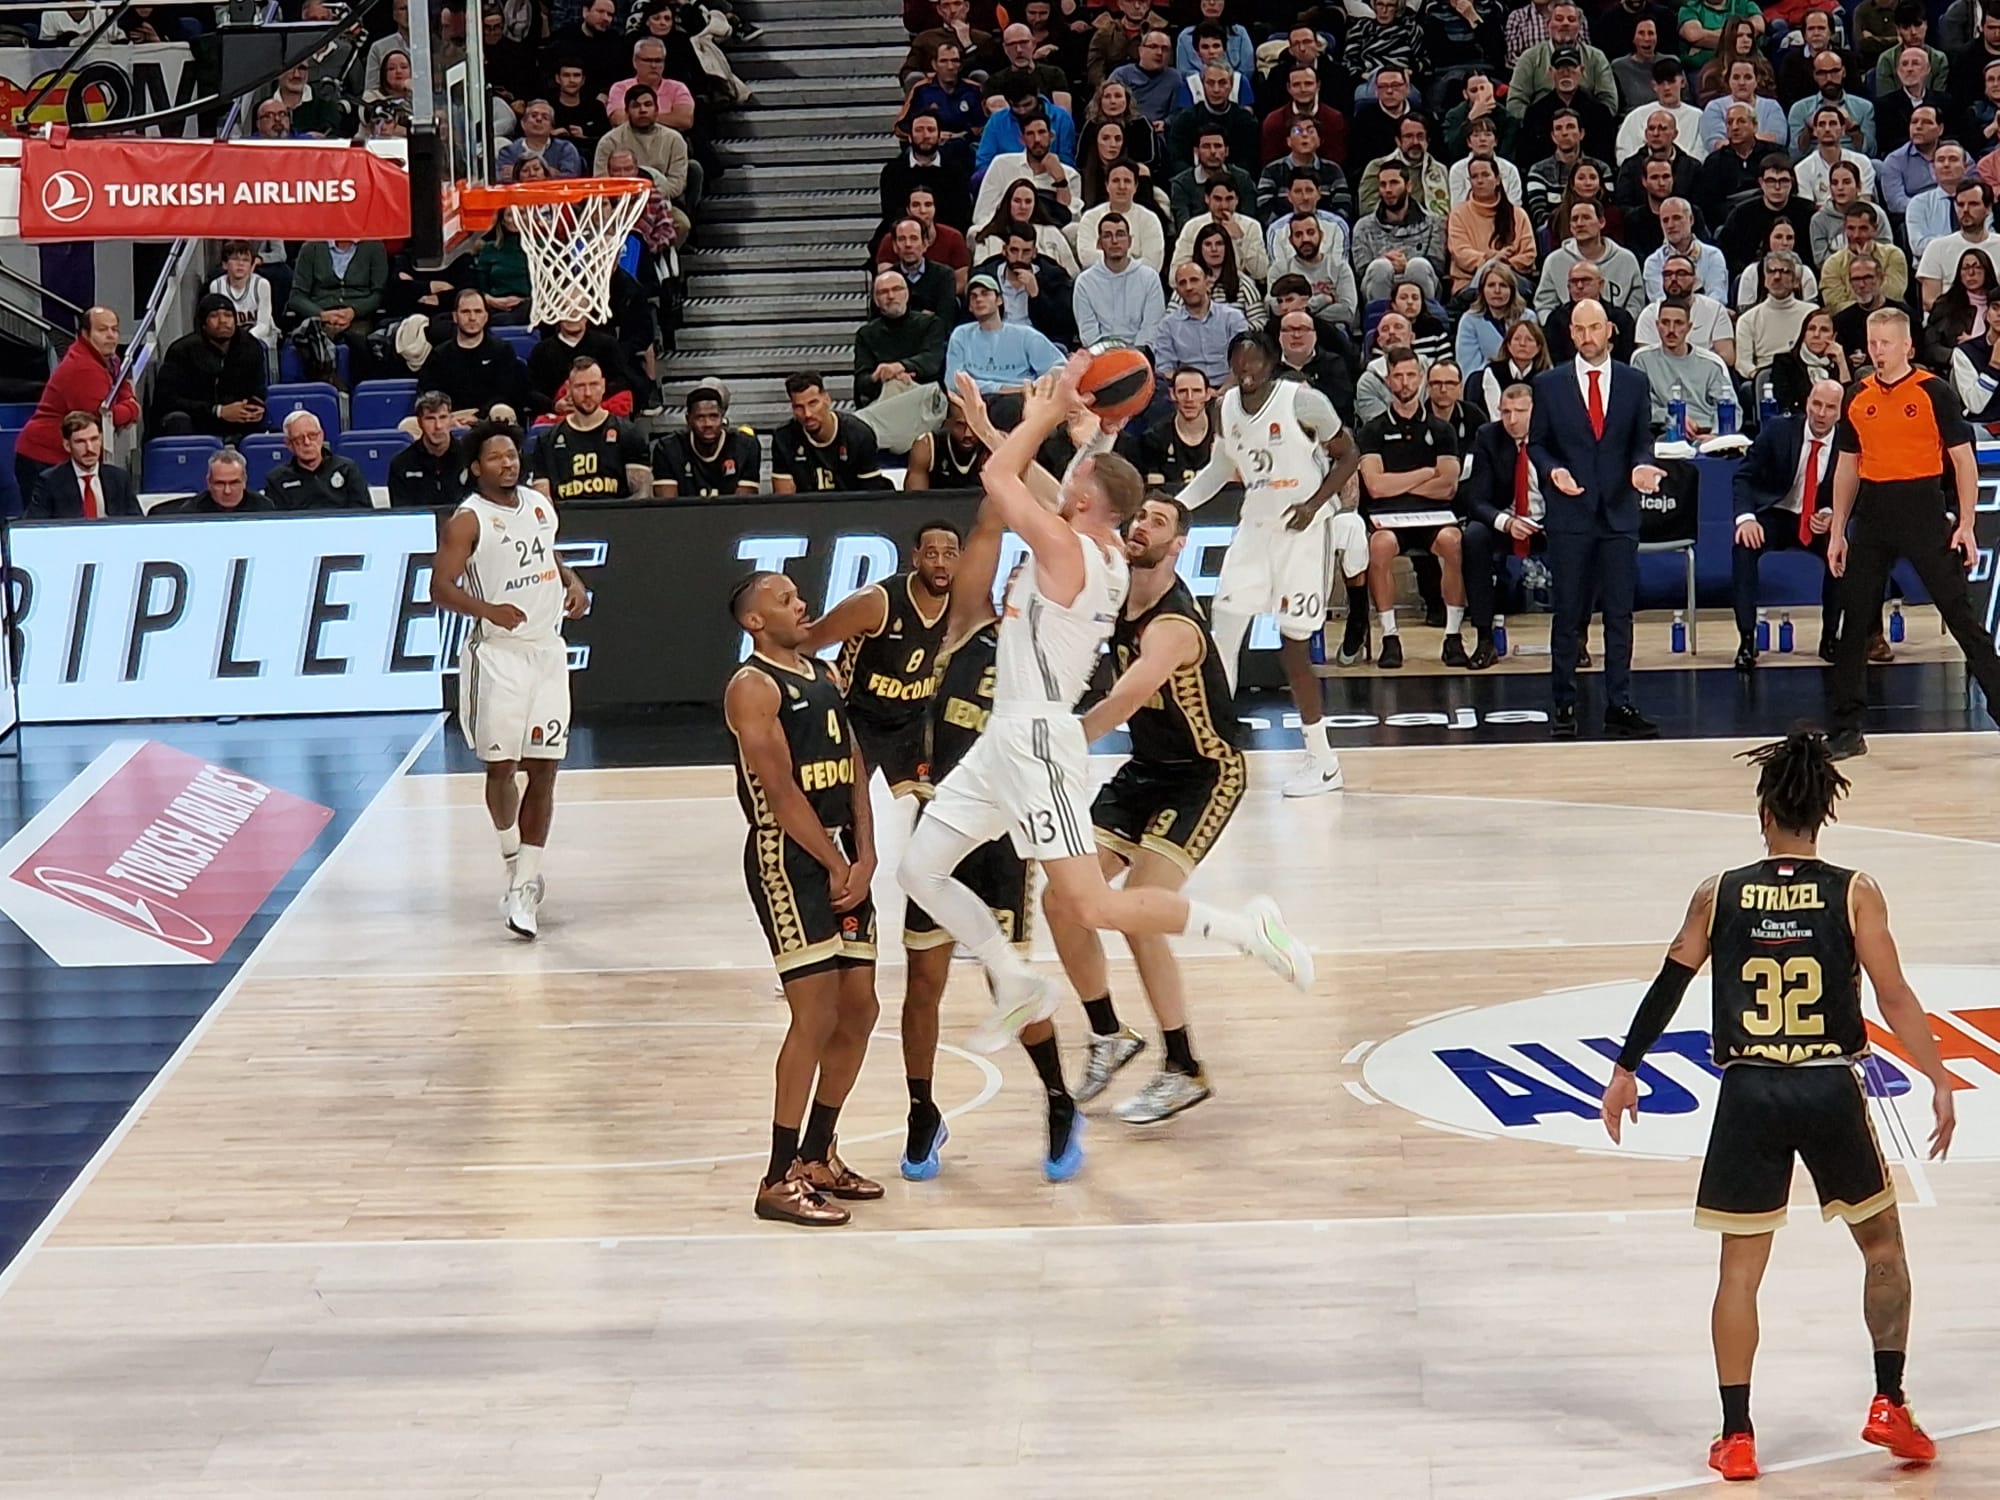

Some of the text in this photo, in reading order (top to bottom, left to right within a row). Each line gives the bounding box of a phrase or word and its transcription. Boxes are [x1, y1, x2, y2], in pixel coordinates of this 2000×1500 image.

[104, 179, 357, 206] TURKISH AIRLINES
[573, 452, 598, 476] 20
[558, 477, 618, 499] FEDCOM
[816, 467, 835, 490] 12
[515, 536, 546, 568] 24
[1290, 592, 1320, 618] 30
[905, 651, 925, 673] 8
[868, 673, 938, 700] FEDCOM
[827, 709, 842, 745] 4
[105, 763, 272, 899] TURKISH AIRLINES
[1740, 882, 1826, 911] STRAZEL
[1741, 956, 1825, 1036] 32
